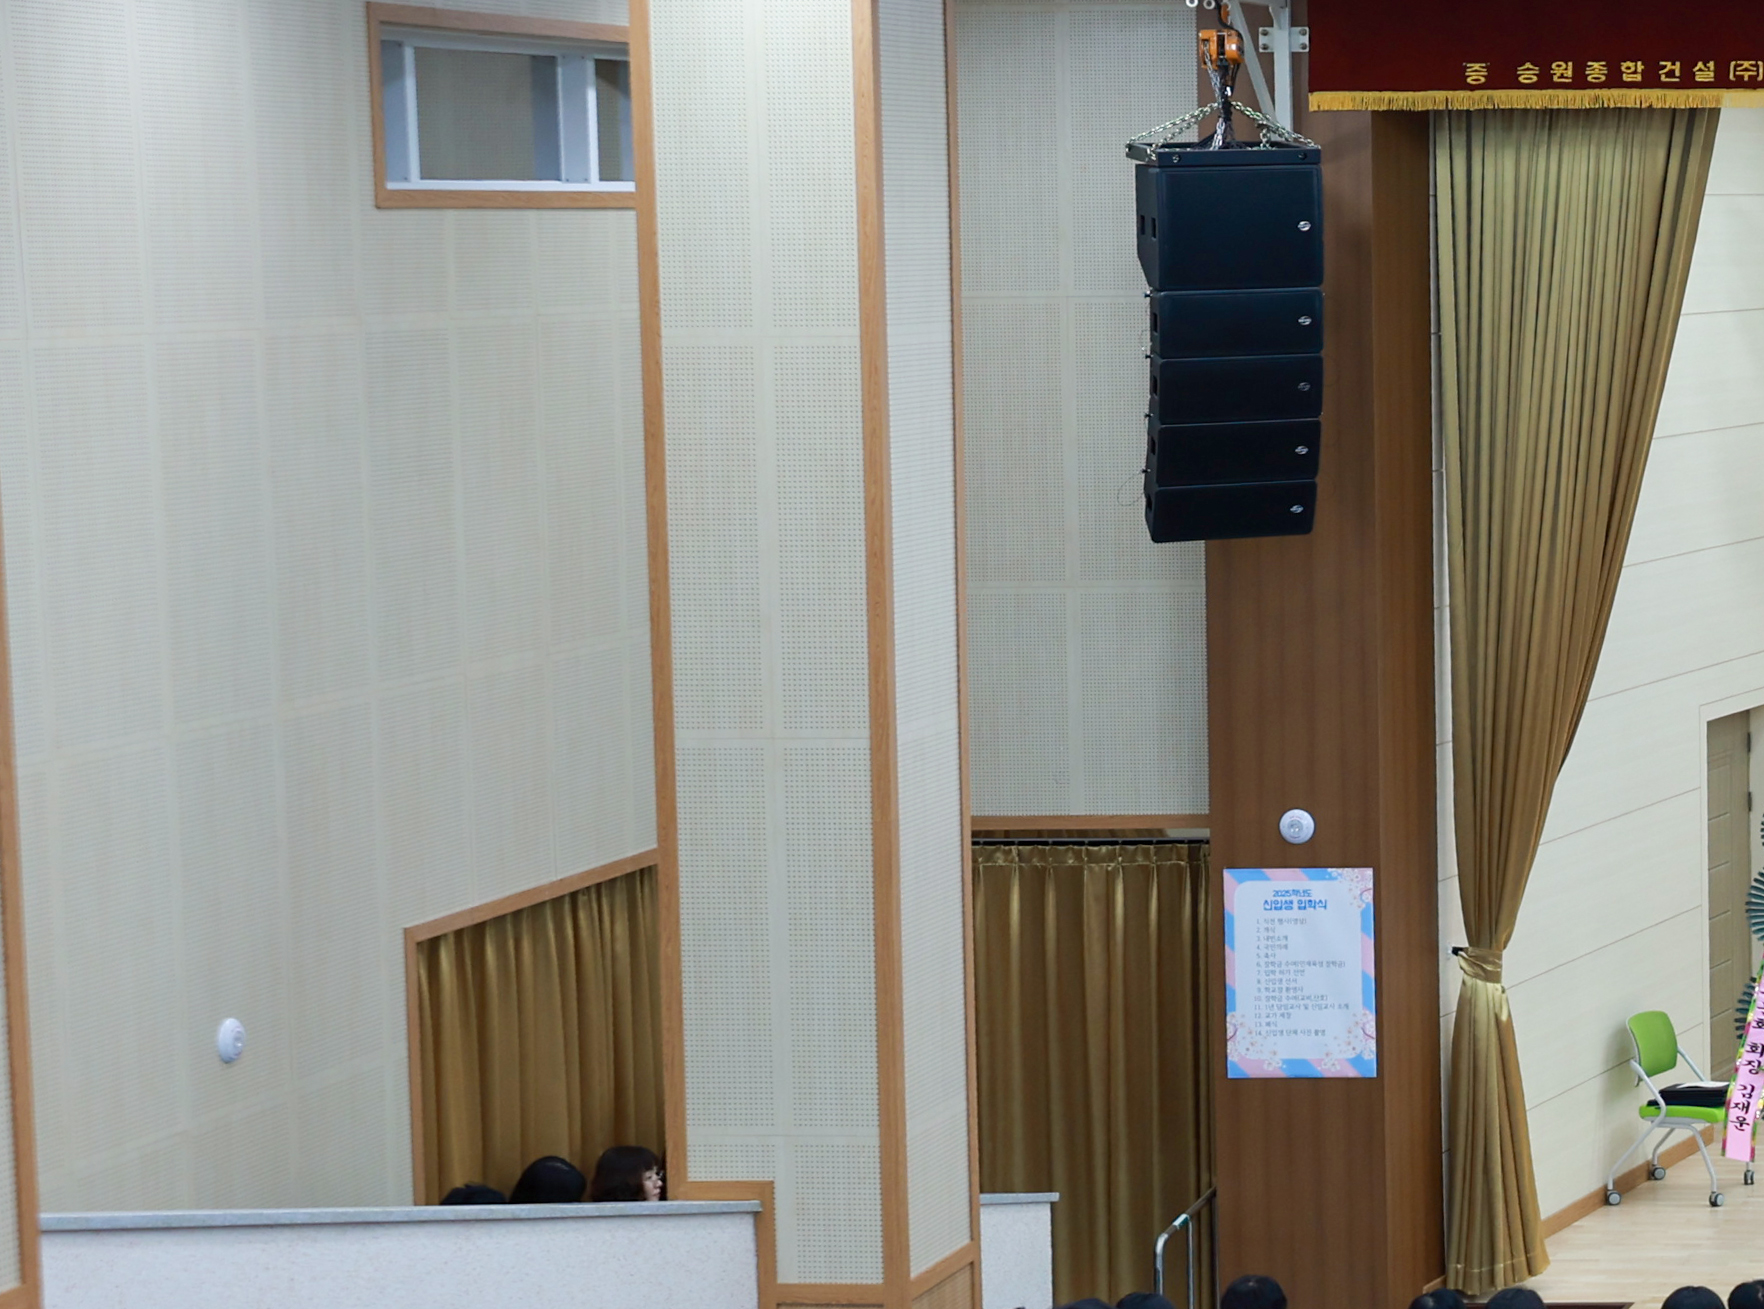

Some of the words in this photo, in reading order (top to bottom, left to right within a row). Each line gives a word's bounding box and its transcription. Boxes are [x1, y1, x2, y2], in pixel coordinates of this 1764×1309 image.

[1263, 900, 1293, 910] 신입생
[1297, 899, 1327, 910] 입학식
[1729, 1084, 1755, 1132] 김재운
